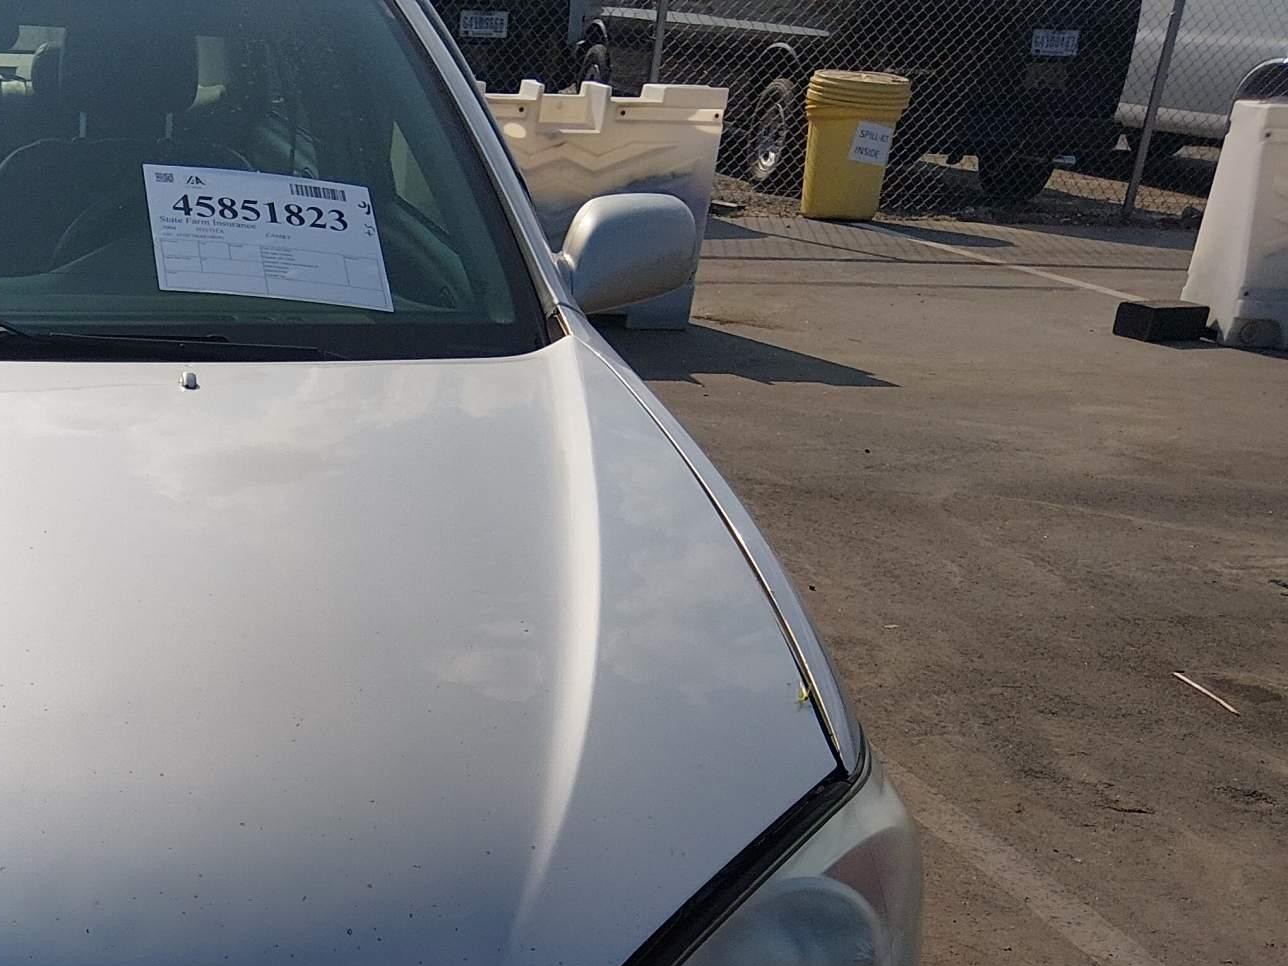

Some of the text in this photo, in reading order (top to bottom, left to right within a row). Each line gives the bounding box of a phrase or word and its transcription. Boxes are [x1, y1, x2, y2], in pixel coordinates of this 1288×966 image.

[159, 215, 257, 230] State Farm Insurance
[172, 194, 348, 231] 45851823
